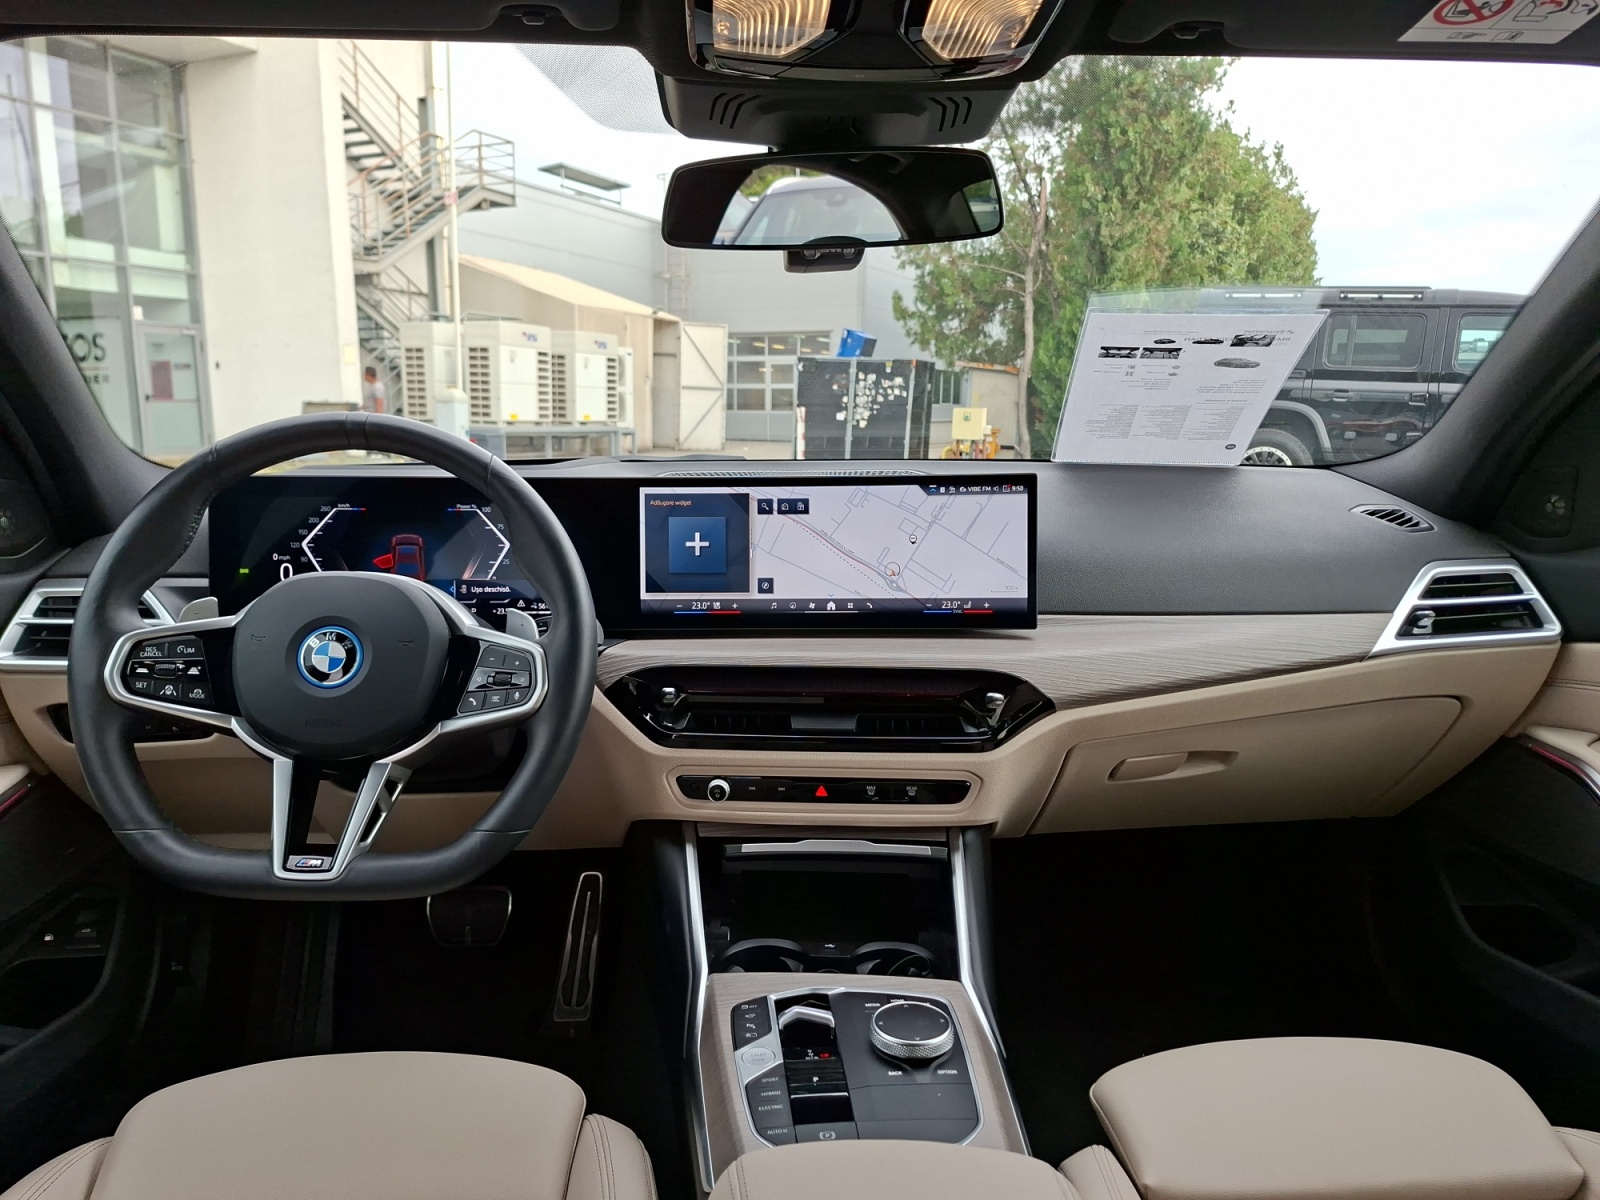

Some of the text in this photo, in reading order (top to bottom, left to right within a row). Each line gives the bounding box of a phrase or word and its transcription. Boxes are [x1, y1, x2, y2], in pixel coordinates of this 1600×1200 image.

[272, 553, 278, 561] 0
[691, 601, 711, 610] 23.0°
[941, 600, 961, 609] 23.0°
[309, 631, 353, 650] BMW
[758, 1103, 784, 1111] ELECTRIC
